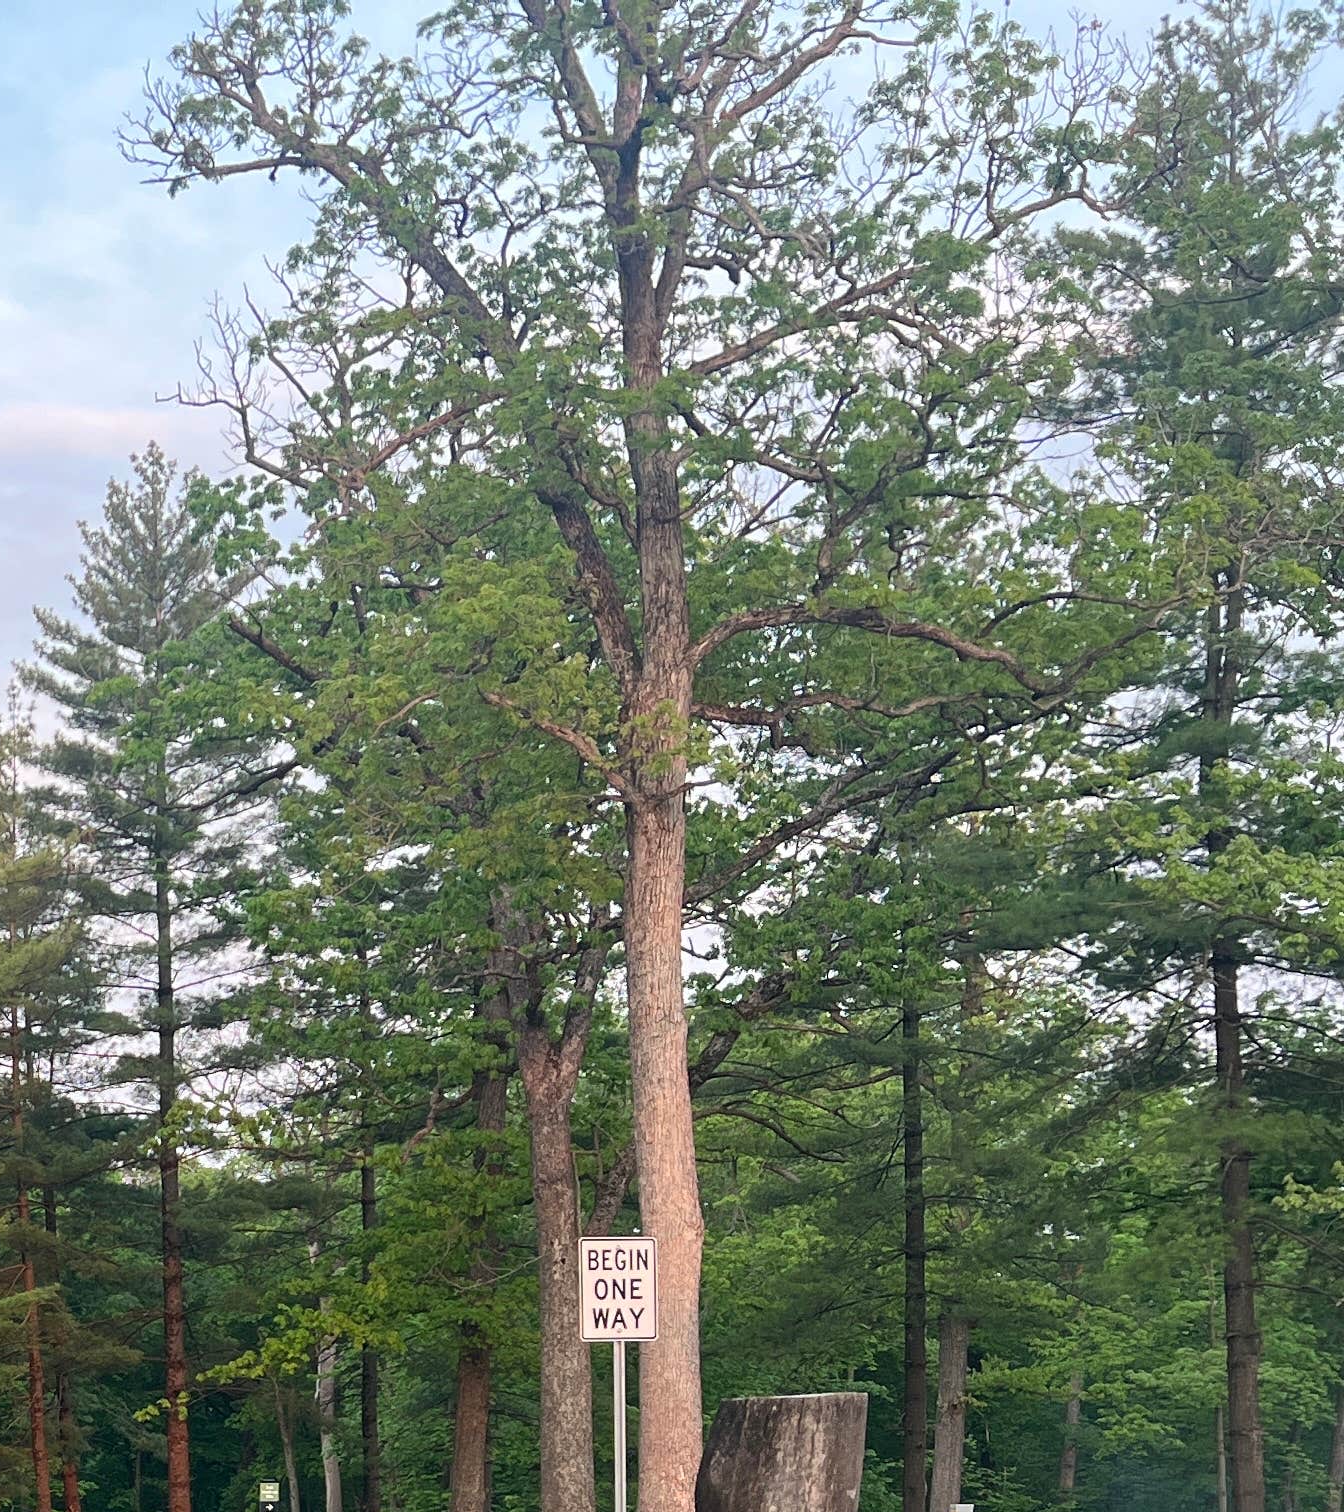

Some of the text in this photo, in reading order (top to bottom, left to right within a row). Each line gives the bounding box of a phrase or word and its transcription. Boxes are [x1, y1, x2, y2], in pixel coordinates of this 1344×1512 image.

[588, 1249, 649, 1271] BEGIN
[594, 1278, 643, 1300] ONE
[592, 1307, 645, 1329] WAY
